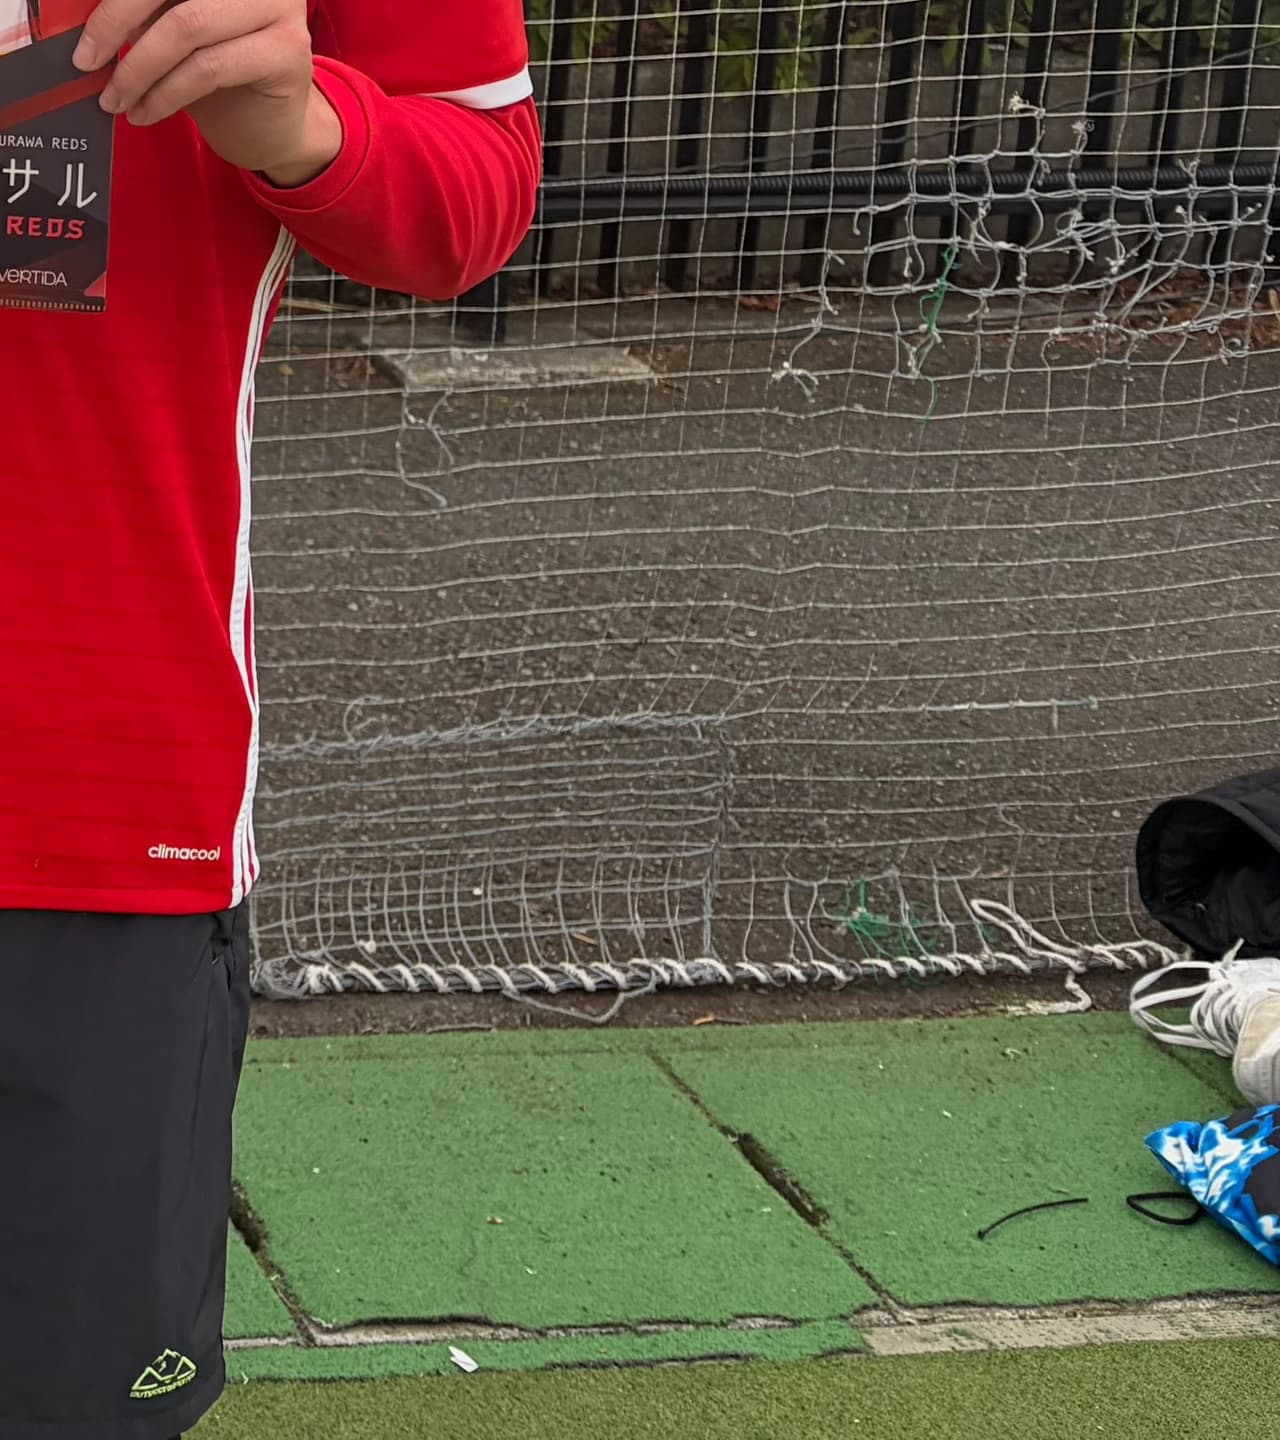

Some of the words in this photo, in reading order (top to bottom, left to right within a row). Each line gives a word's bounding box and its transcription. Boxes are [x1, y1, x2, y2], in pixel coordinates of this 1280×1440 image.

[51, 137, 88, 151] REDS
[6, 215, 86, 240] REDS
[148, 843, 221, 861] climacool
